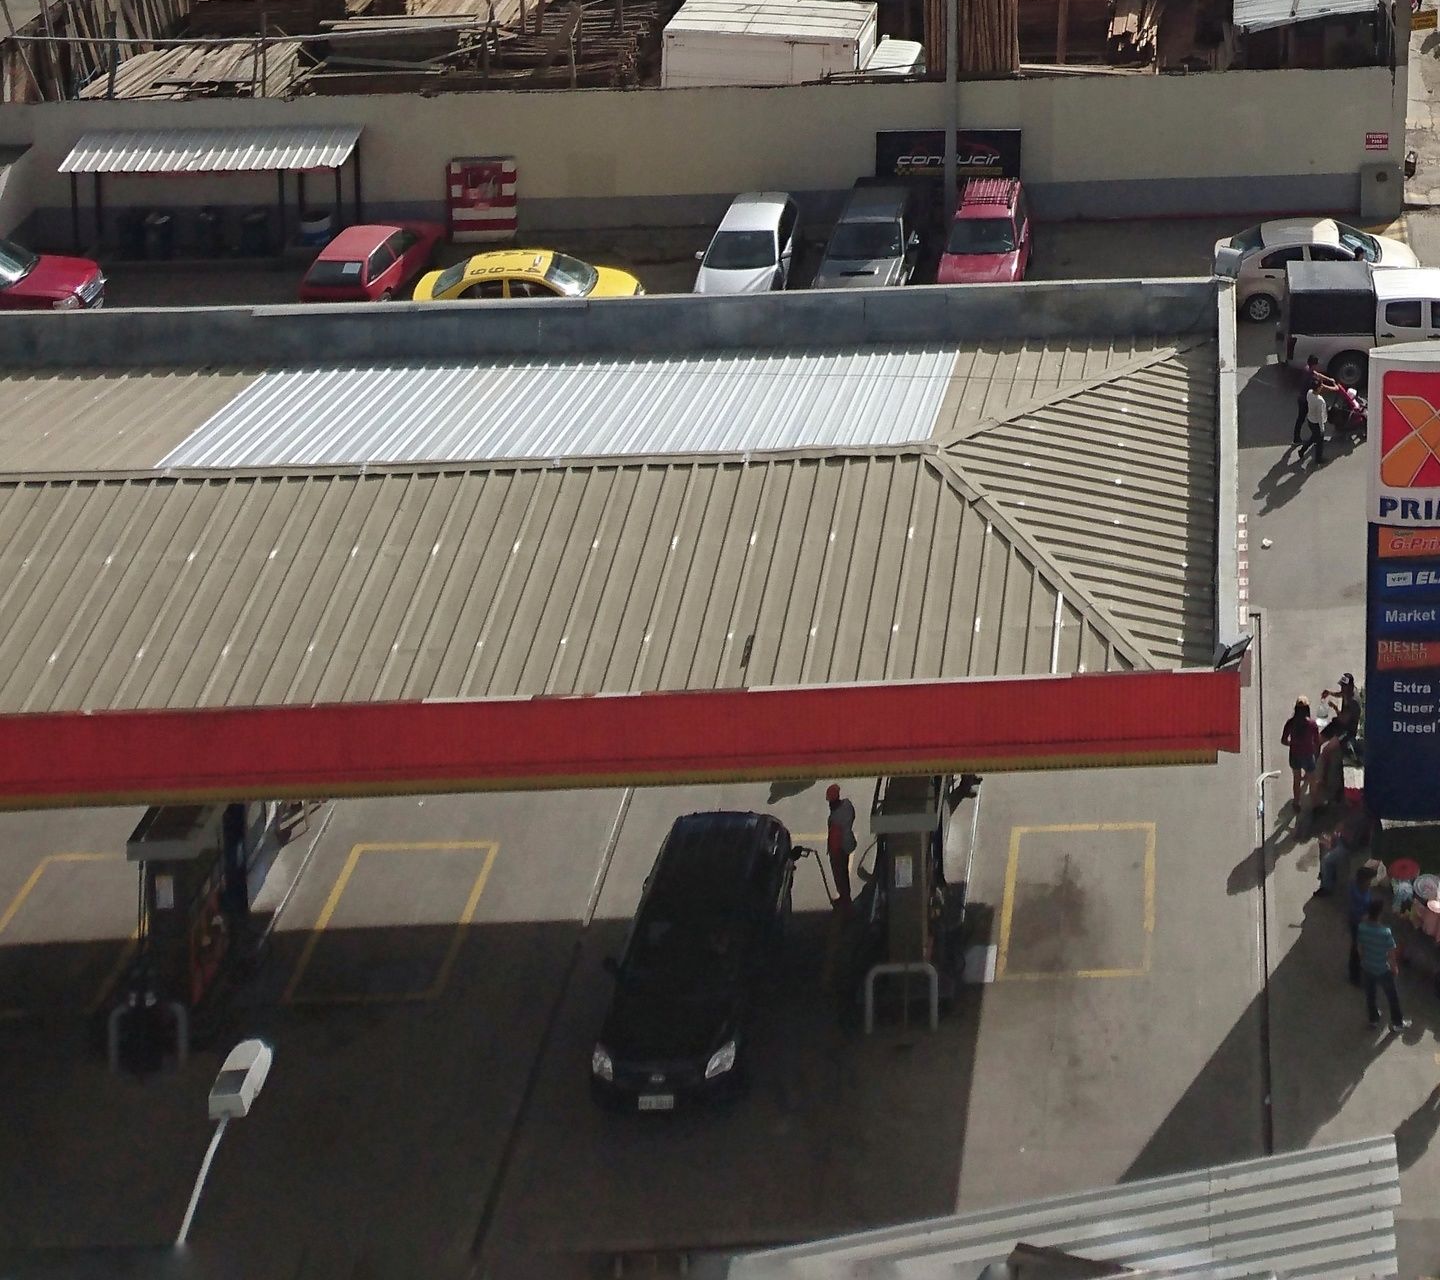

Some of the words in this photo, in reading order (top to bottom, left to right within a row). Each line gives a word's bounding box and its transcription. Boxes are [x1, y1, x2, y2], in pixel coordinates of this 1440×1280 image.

[896, 153, 1000, 165] conucir
[1385, 610, 1436, 623] Market
[1378, 640, 1427, 653] DIESEL
[1393, 681, 1431, 694] Extra
[1393, 701, 1434, 714] Super
[1392, 720, 1436, 734] Diesel
